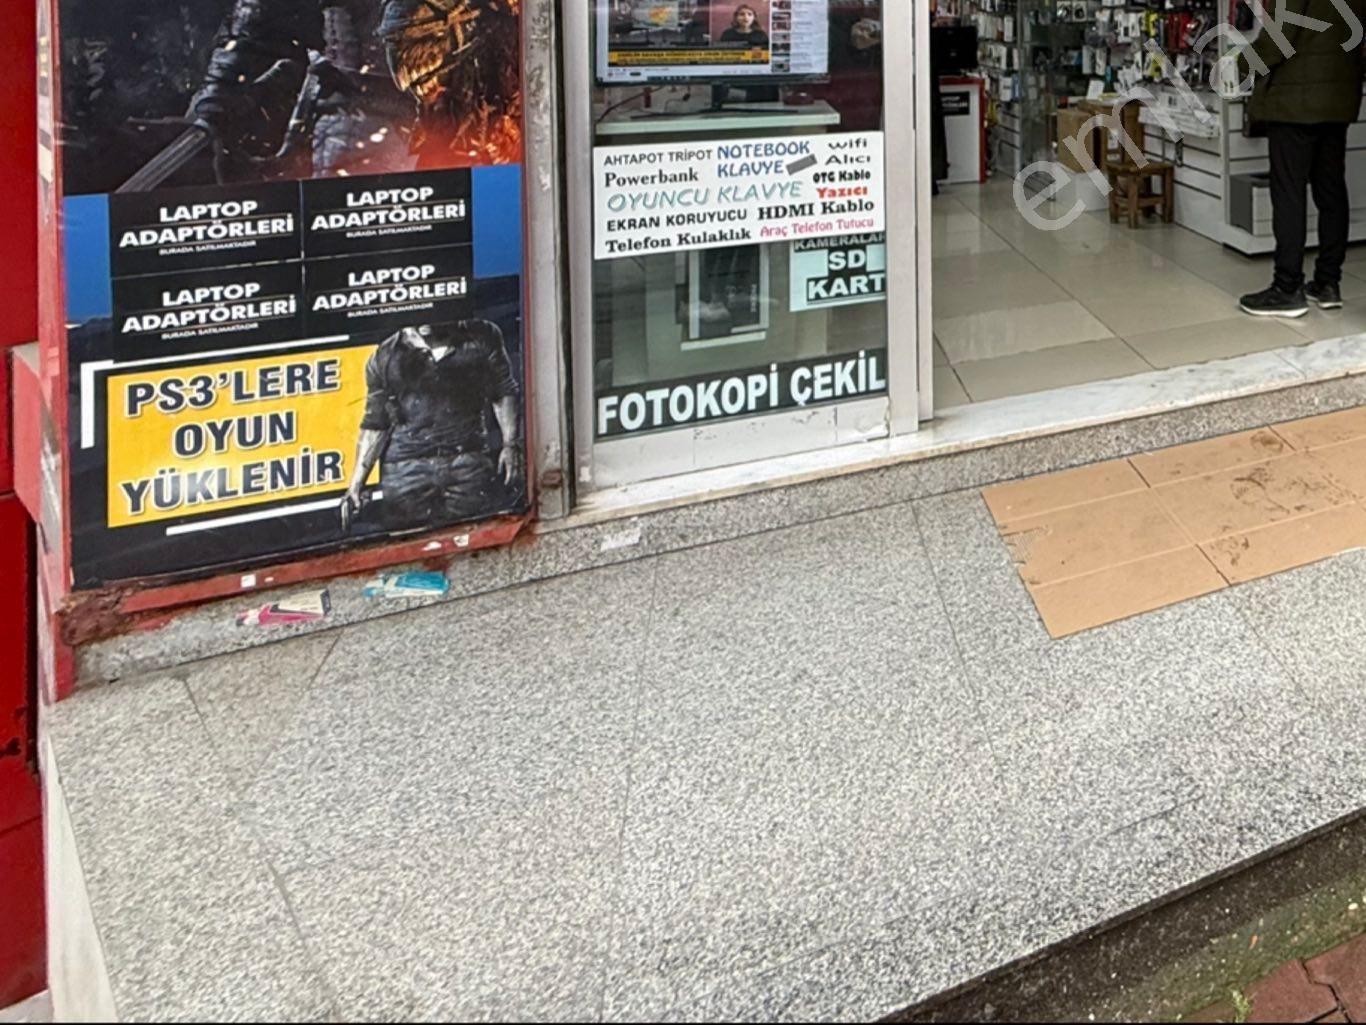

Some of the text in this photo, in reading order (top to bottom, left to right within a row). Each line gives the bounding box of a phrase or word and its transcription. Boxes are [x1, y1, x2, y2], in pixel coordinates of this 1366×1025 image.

[604, 148, 713, 166] AHTAPOT TRİPOT
[717, 141, 810, 159] NOTEBOOK
[604, 167, 699, 188] Powerbank
[717, 160, 784, 178] KLAVYE
[838, 169, 871, 182] Kablo
[346, 186, 434, 207] LAPTOP
[607, 181, 803, 213] OYUNCU KLAVYE
[816, 186, 868, 199] Yazıcı
[160, 200, 258, 223] LAPTOP
[311, 199, 466, 231] ADAPTÖRLERİ
[607, 208, 747, 232] EKRAN KORUYUCU
[757, 198, 875, 221] HDMI Kablo
[119, 213, 294, 248] ADAPTÖRLERİ
[760, 217, 874, 238] Araç Telefon Tutucu
[159, 246, 194, 256] BURADA
[605, 228, 752, 253] Telefon Kulaklık
[828, 249, 866, 272] SD
[348, 264, 435, 287] LAPTOP
[807, 274, 886, 300] KART
[162, 282, 260, 307] LAPTOP
[312, 276, 467, 311] ADAPTÖRLERİ
[121, 294, 296, 333] ADAPTÖRLERİ
[125, 357, 341, 417] PS3'LERE
[598, 349, 886, 436] FOTOKOPİ ÇEKİL
[174, 410, 296, 458] OYUN
[121, 449, 342, 516] YÜKLENİR
